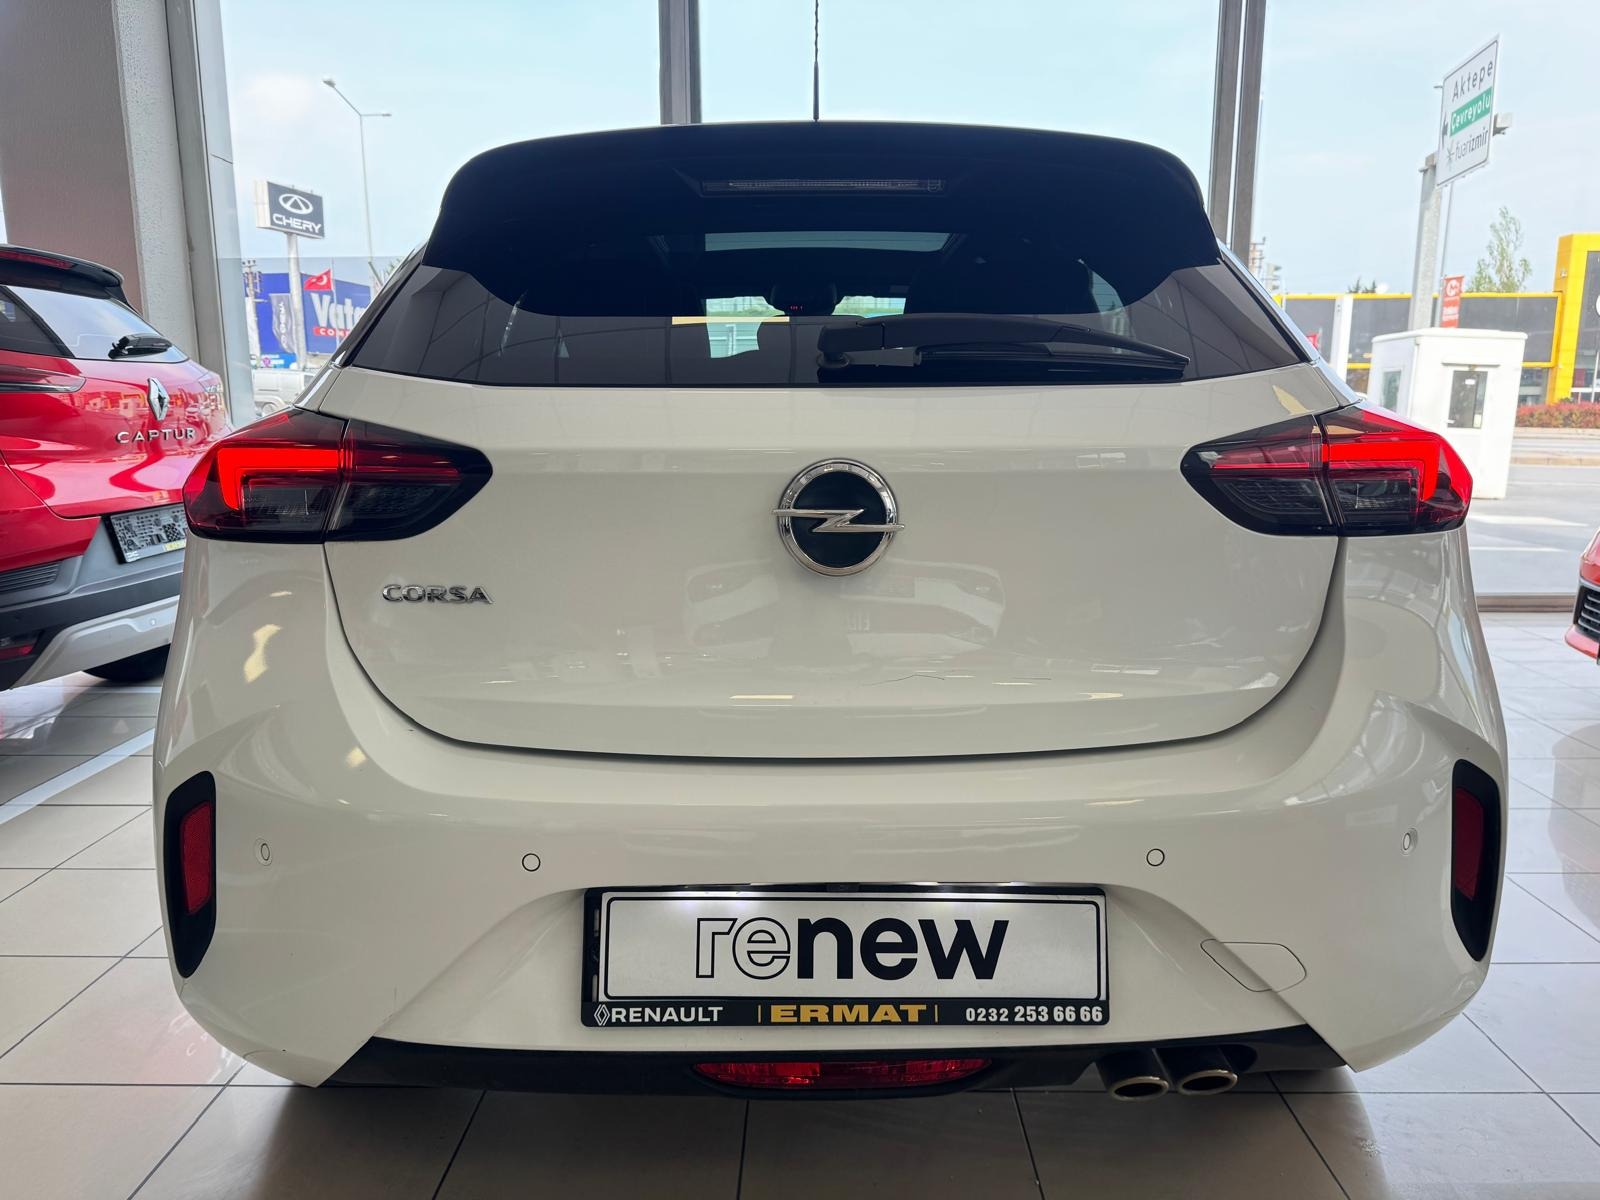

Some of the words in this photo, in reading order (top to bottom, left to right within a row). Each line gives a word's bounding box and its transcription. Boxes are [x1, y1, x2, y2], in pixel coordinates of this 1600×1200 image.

[1452, 60, 1493, 102] Aktepe
[272, 213, 322, 234] CHERY
[115, 427, 196, 444] CAPTUR
[382, 584, 494, 604] CORSA
[695, 916, 1010, 981] renew
[611, 1006, 724, 1023] RENAULT
[770, 1004, 927, 1023] ERMAT
[965, 1007, 1009, 1022] 0232
[1013, 1005, 1049, 1022] 253
[1053, 1006, 1076, 1022] 66
[1079, 1006, 1103, 1022] 66
